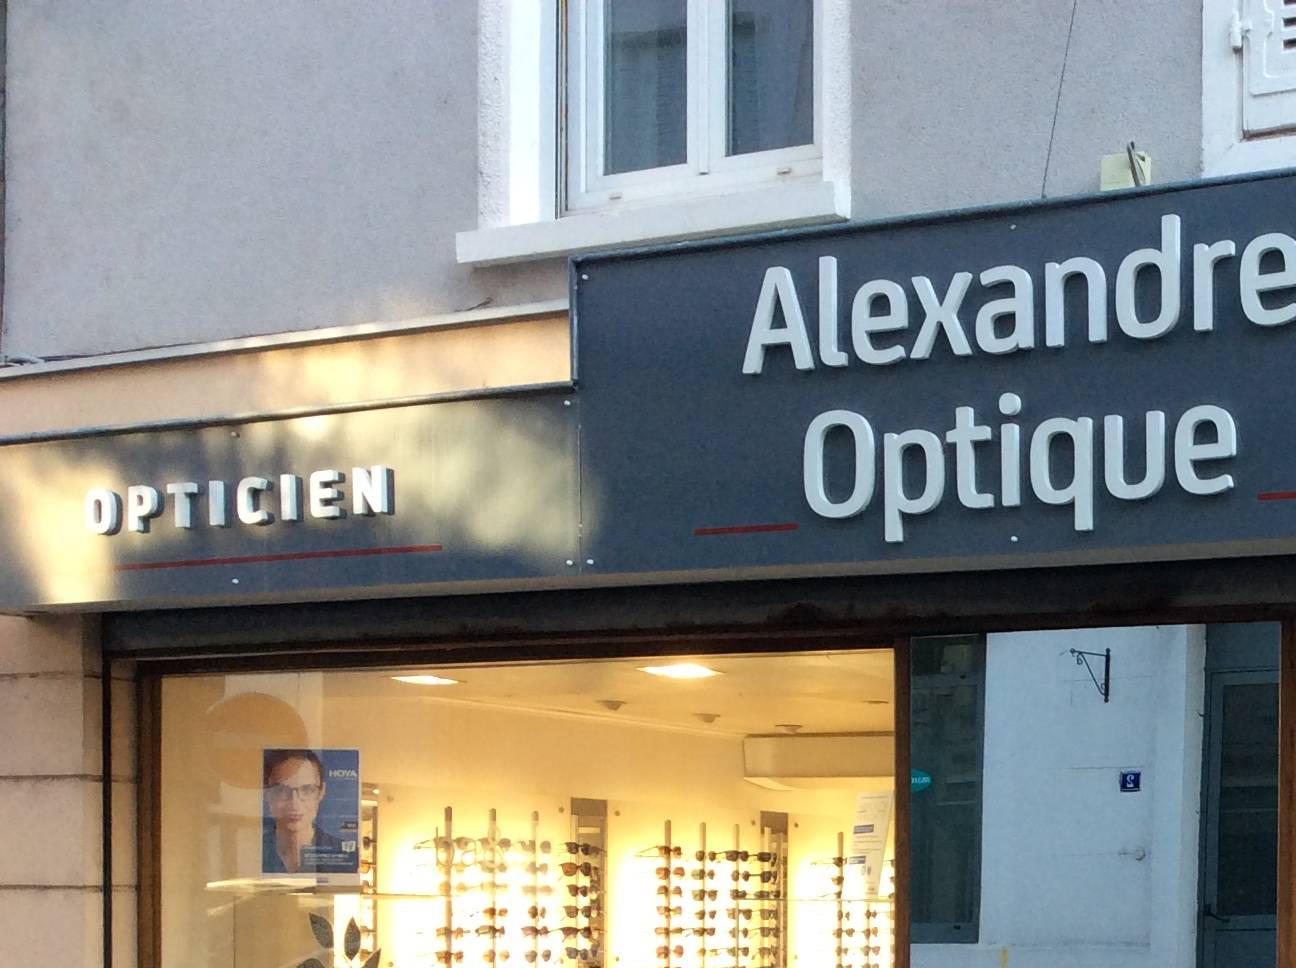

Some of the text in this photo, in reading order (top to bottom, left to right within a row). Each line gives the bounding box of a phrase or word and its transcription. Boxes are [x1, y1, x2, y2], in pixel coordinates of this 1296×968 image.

[84, 464, 394, 536] OPTICIEN
[803, 391, 1238, 543] Optique
[328, 769, 358, 778] HOYA
